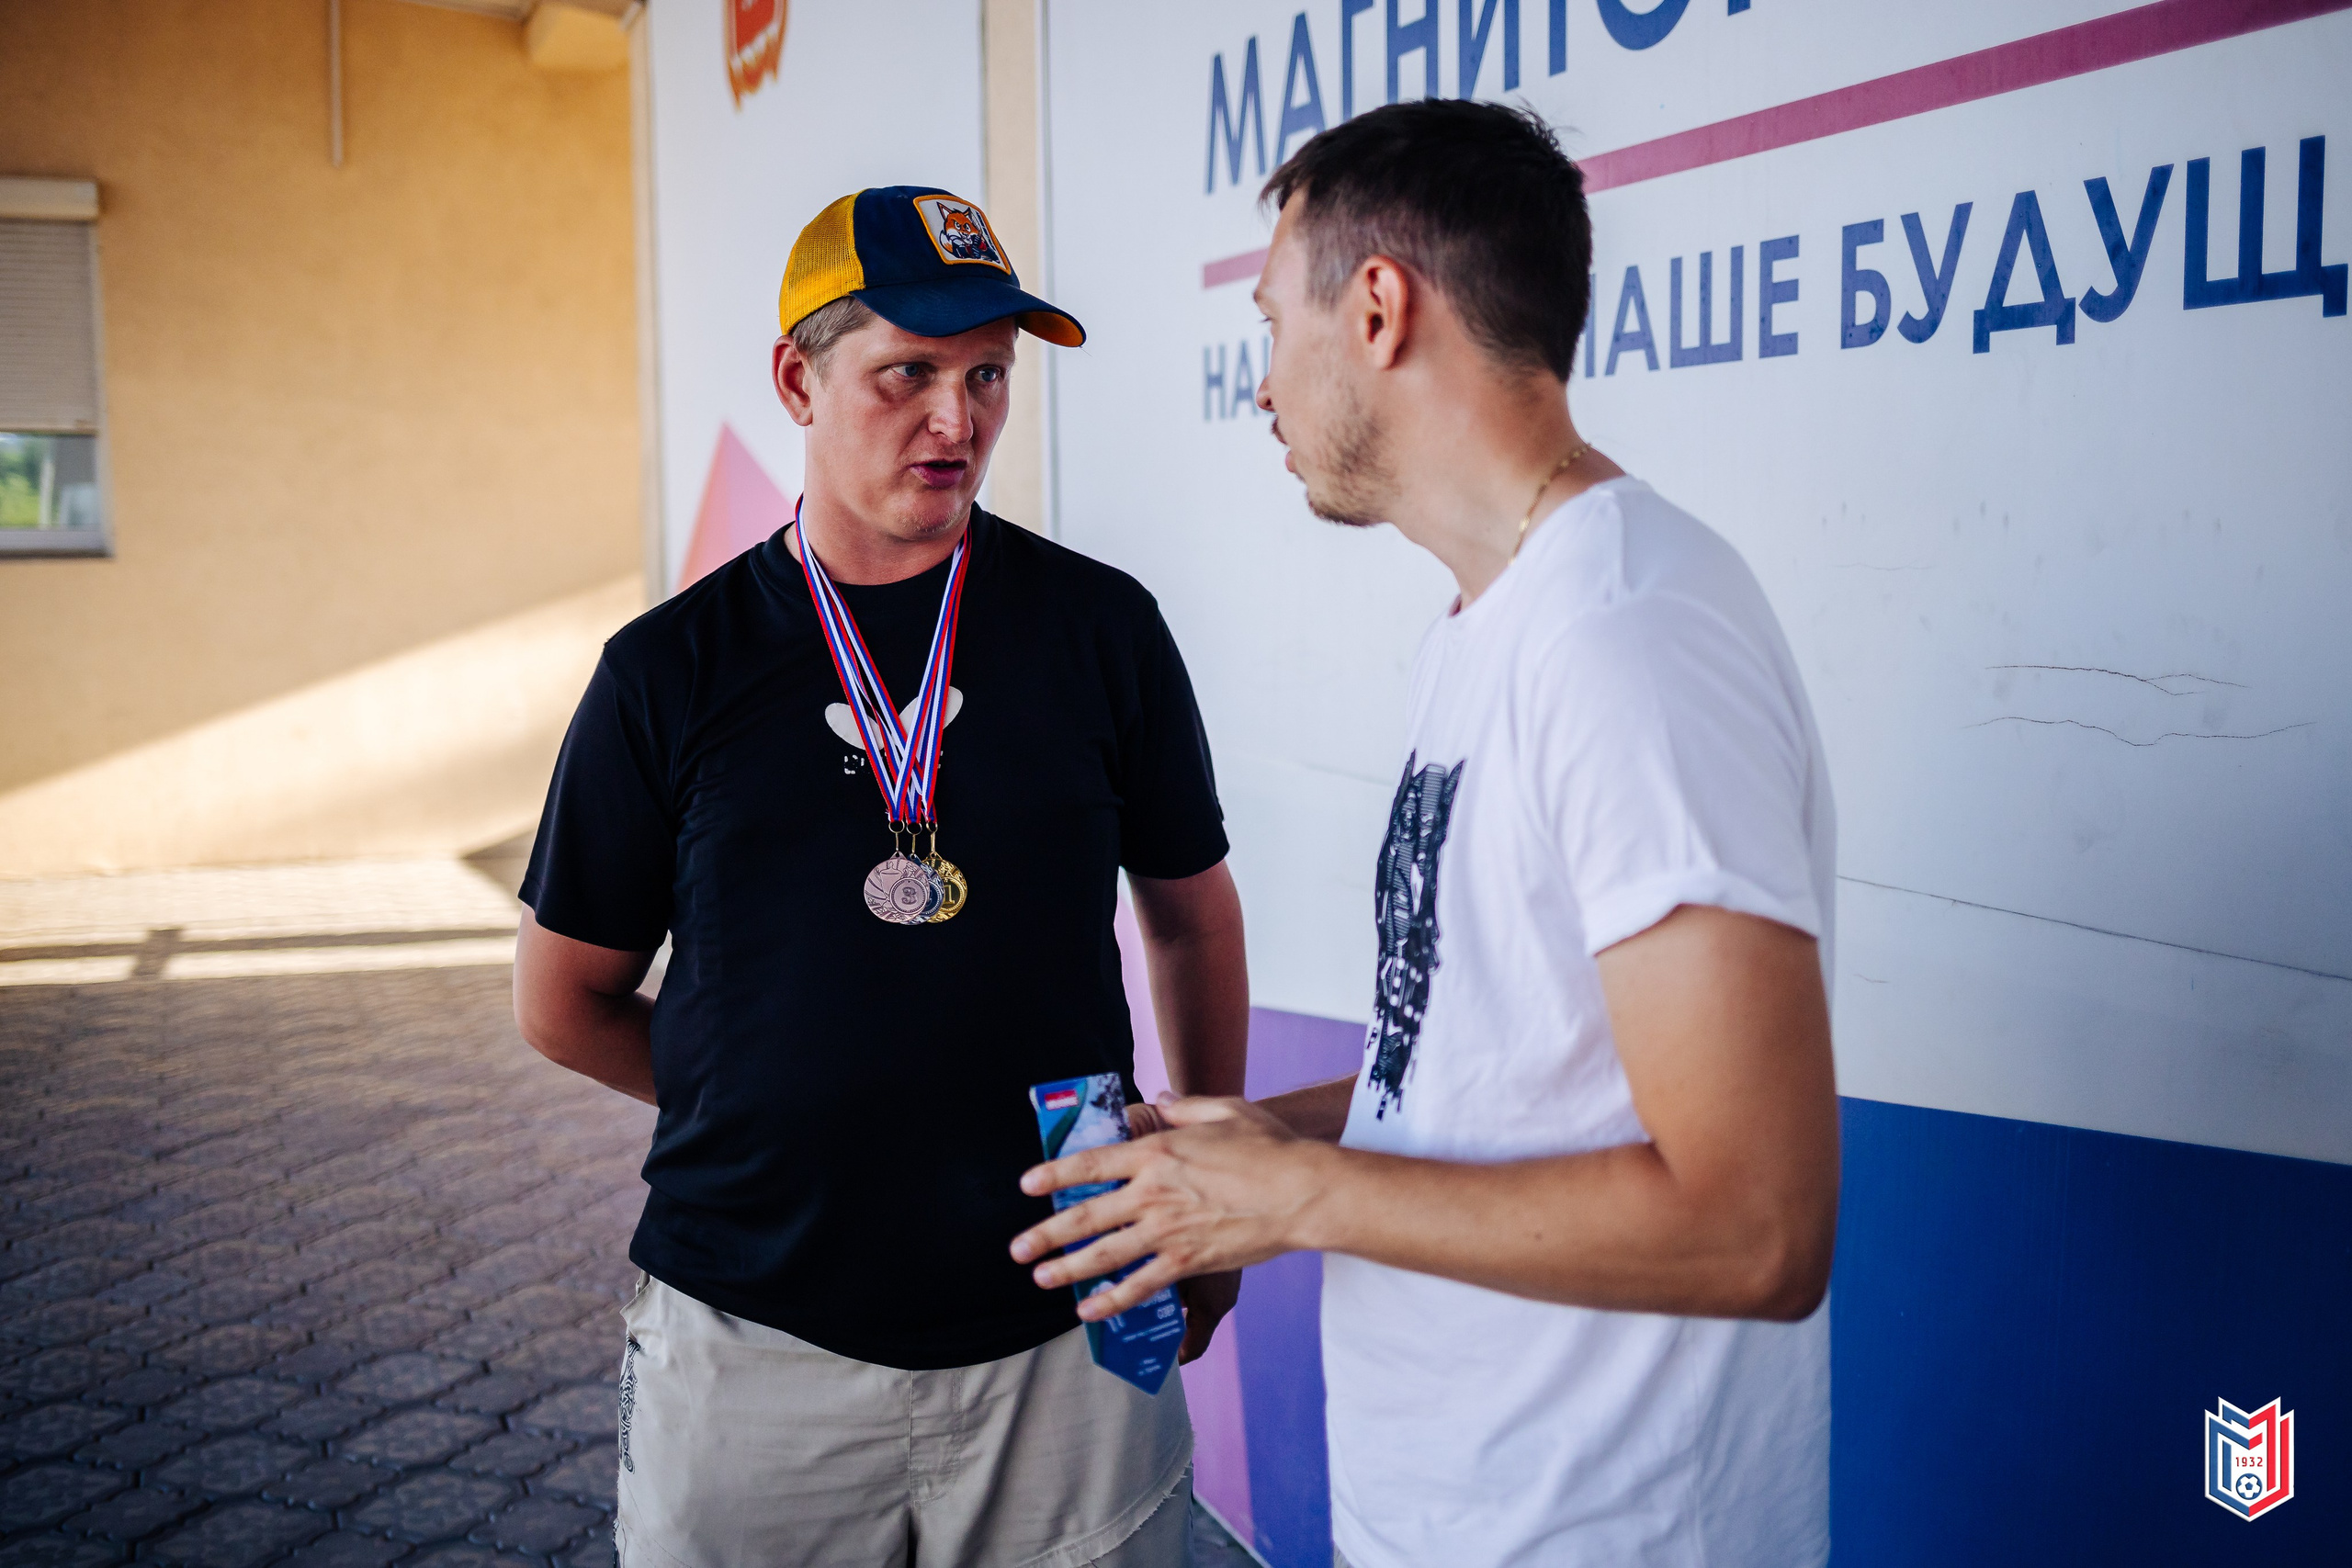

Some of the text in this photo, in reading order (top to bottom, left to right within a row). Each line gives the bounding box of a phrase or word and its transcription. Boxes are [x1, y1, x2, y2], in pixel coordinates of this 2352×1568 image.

[1204, 334, 1272, 421] НА
[1840, 134, 2348, 355] БУДУЩ
[901, 886, 917, 905] 3
